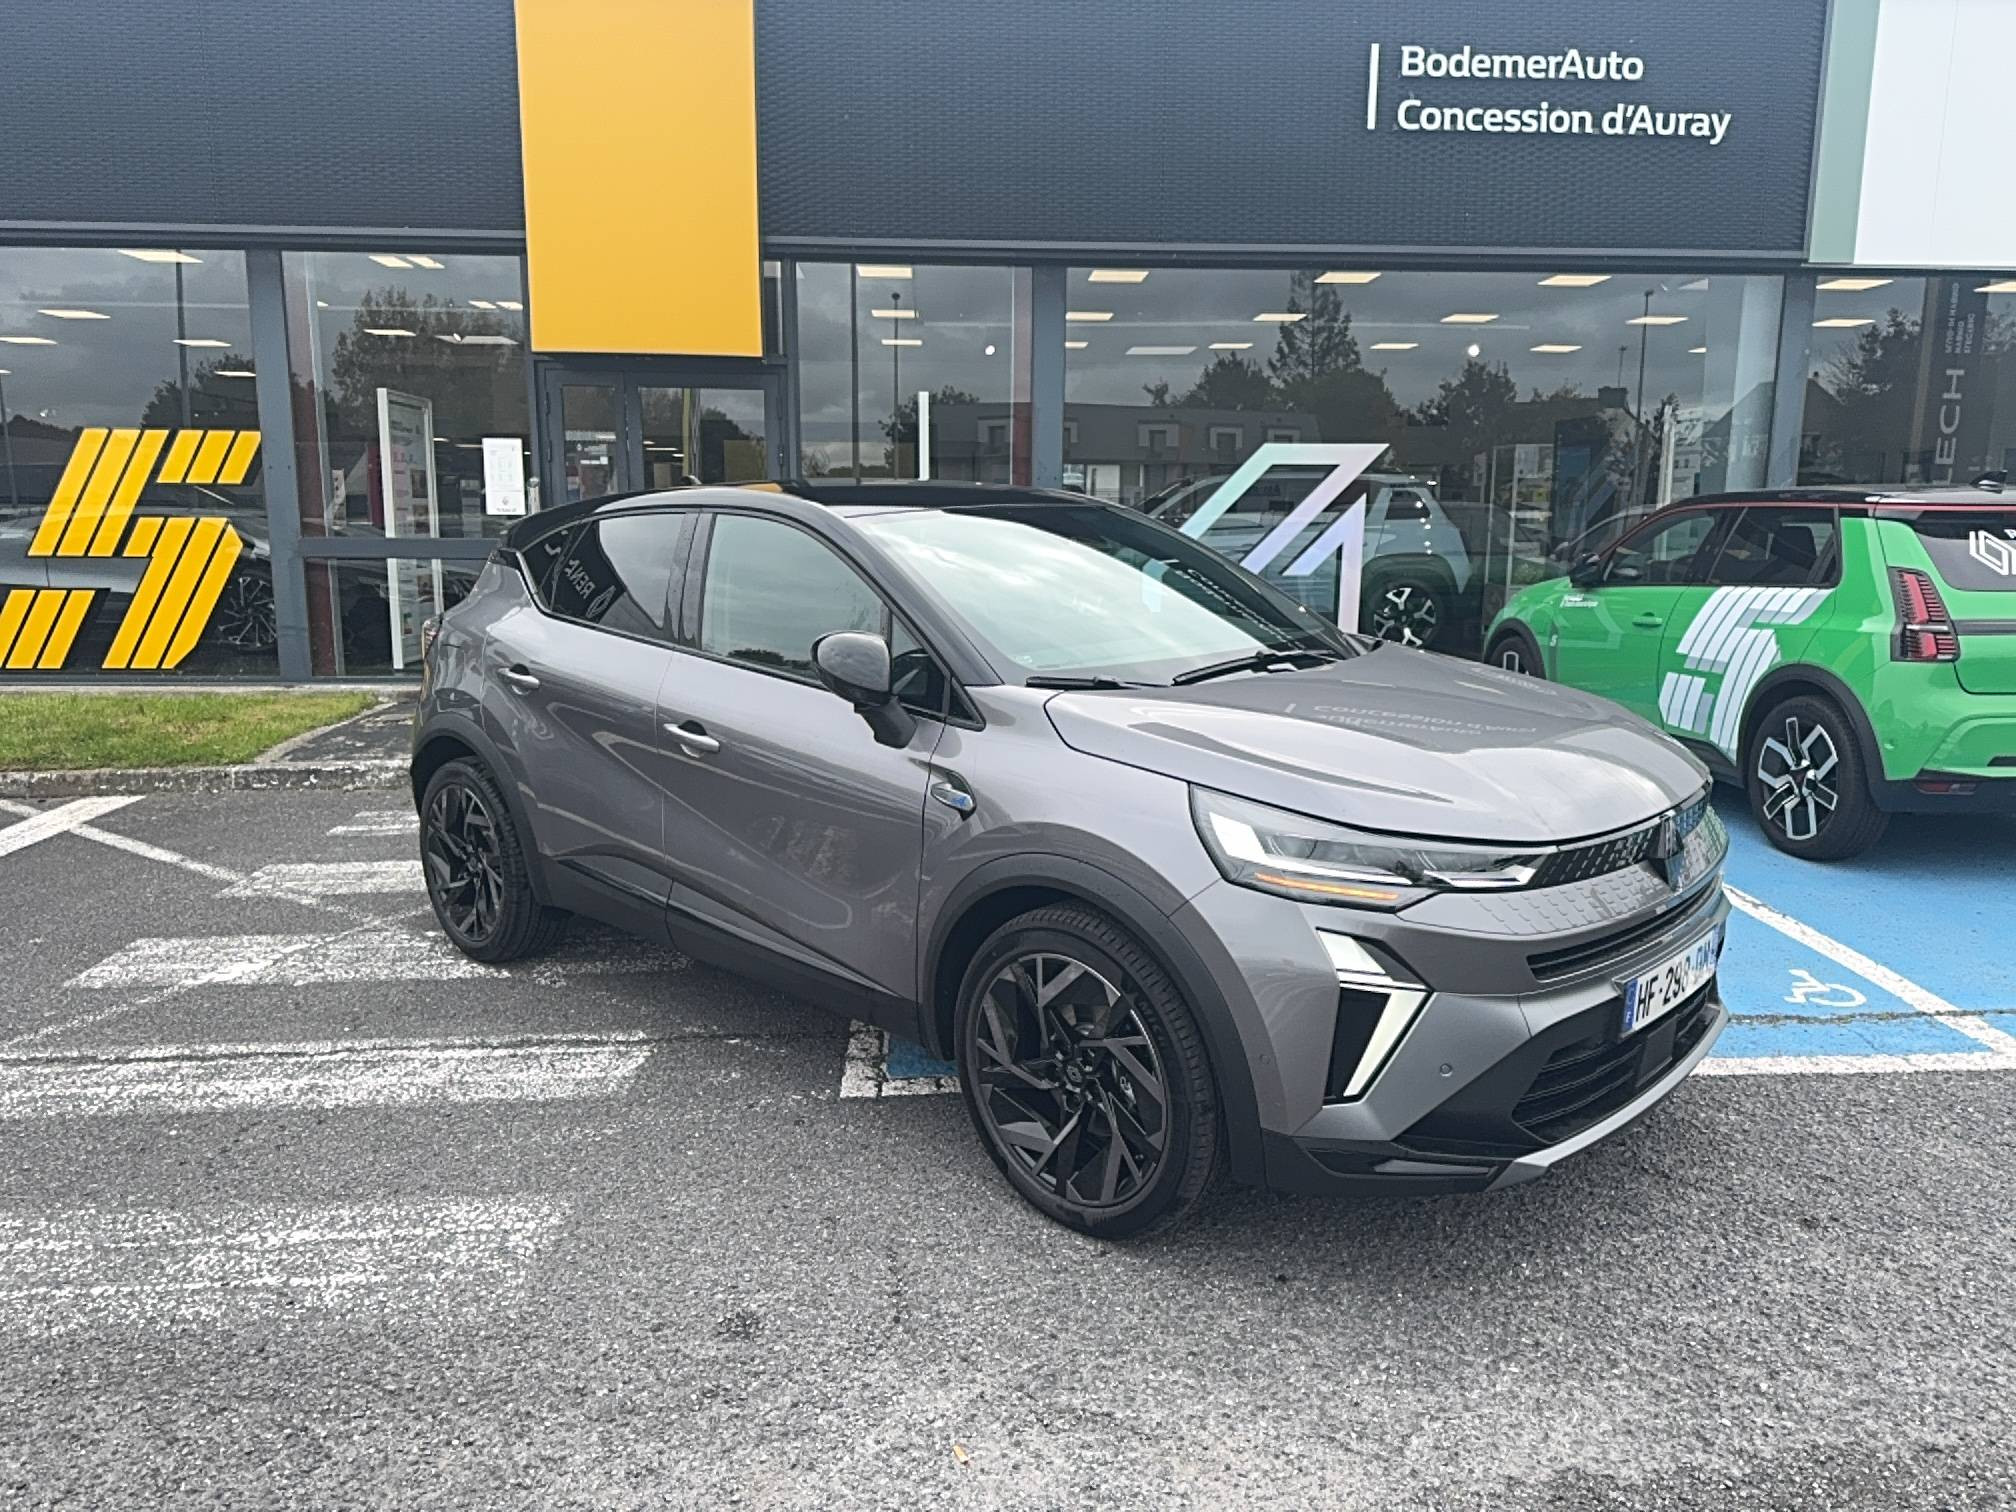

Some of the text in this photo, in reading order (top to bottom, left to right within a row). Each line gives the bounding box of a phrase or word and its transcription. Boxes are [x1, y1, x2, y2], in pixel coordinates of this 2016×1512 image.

[1400, 45, 1644, 80] BodemerAuto
[1397, 99, 1732, 145] Concession d'Auray
